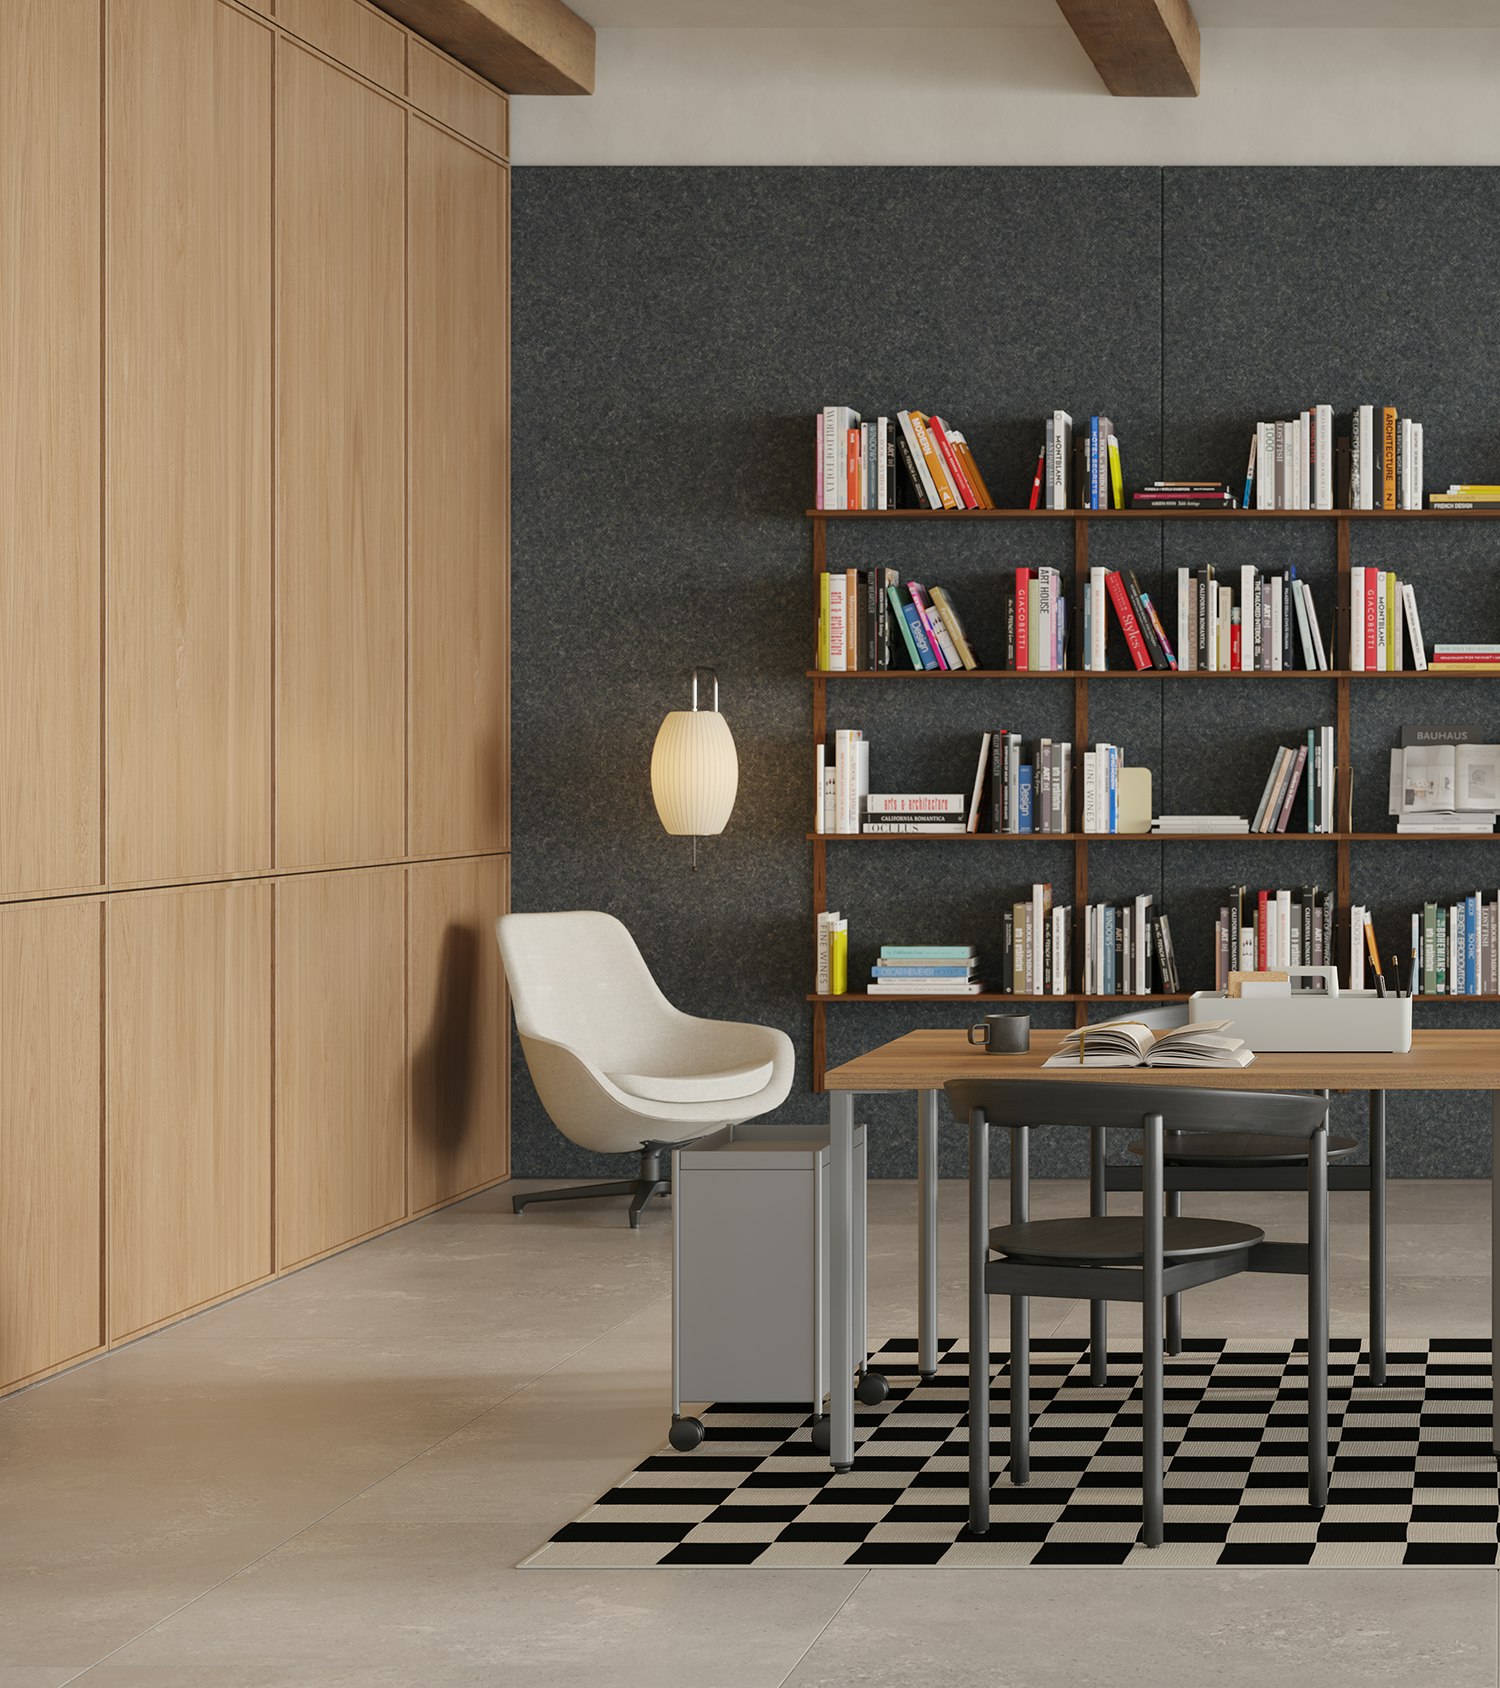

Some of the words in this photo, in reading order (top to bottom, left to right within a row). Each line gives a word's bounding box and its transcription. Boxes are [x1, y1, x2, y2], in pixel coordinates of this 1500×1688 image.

[911, 417, 932, 456] MODERN
[1265, 427, 1274, 453] 1000
[1276, 423, 1284, 443] LOST
[887, 443, 895, 457] ART
[1385, 413, 1393, 481] ARCHITECTURE
[1040, 569, 1049, 585] ART
[1040, 587, 1049, 614] HOUSE
[1263, 603, 1271, 617] ART
[911, 619, 929, 654] Design
[1122, 614, 1141, 649] Styles
[1416, 731, 1468, 740] BAUHAUS
[1043, 766, 1051, 781] ART
[1086, 763, 1094, 787] FINE
[1021, 783, 1031, 816] Design
[1086, 789, 1094, 823] WINES
[1457, 904, 1465, 933] ALEXEY
[1482, 908, 1490, 928] LOST
[820, 924, 828, 948] FINE
[1115, 927, 1123, 942] ART
[1314, 928, 1322, 942] ART
[1482, 929, 1490, 947] FISH
[1437, 927, 1445, 972] BOHEMIANS
[820, 952, 828, 984] WINES
